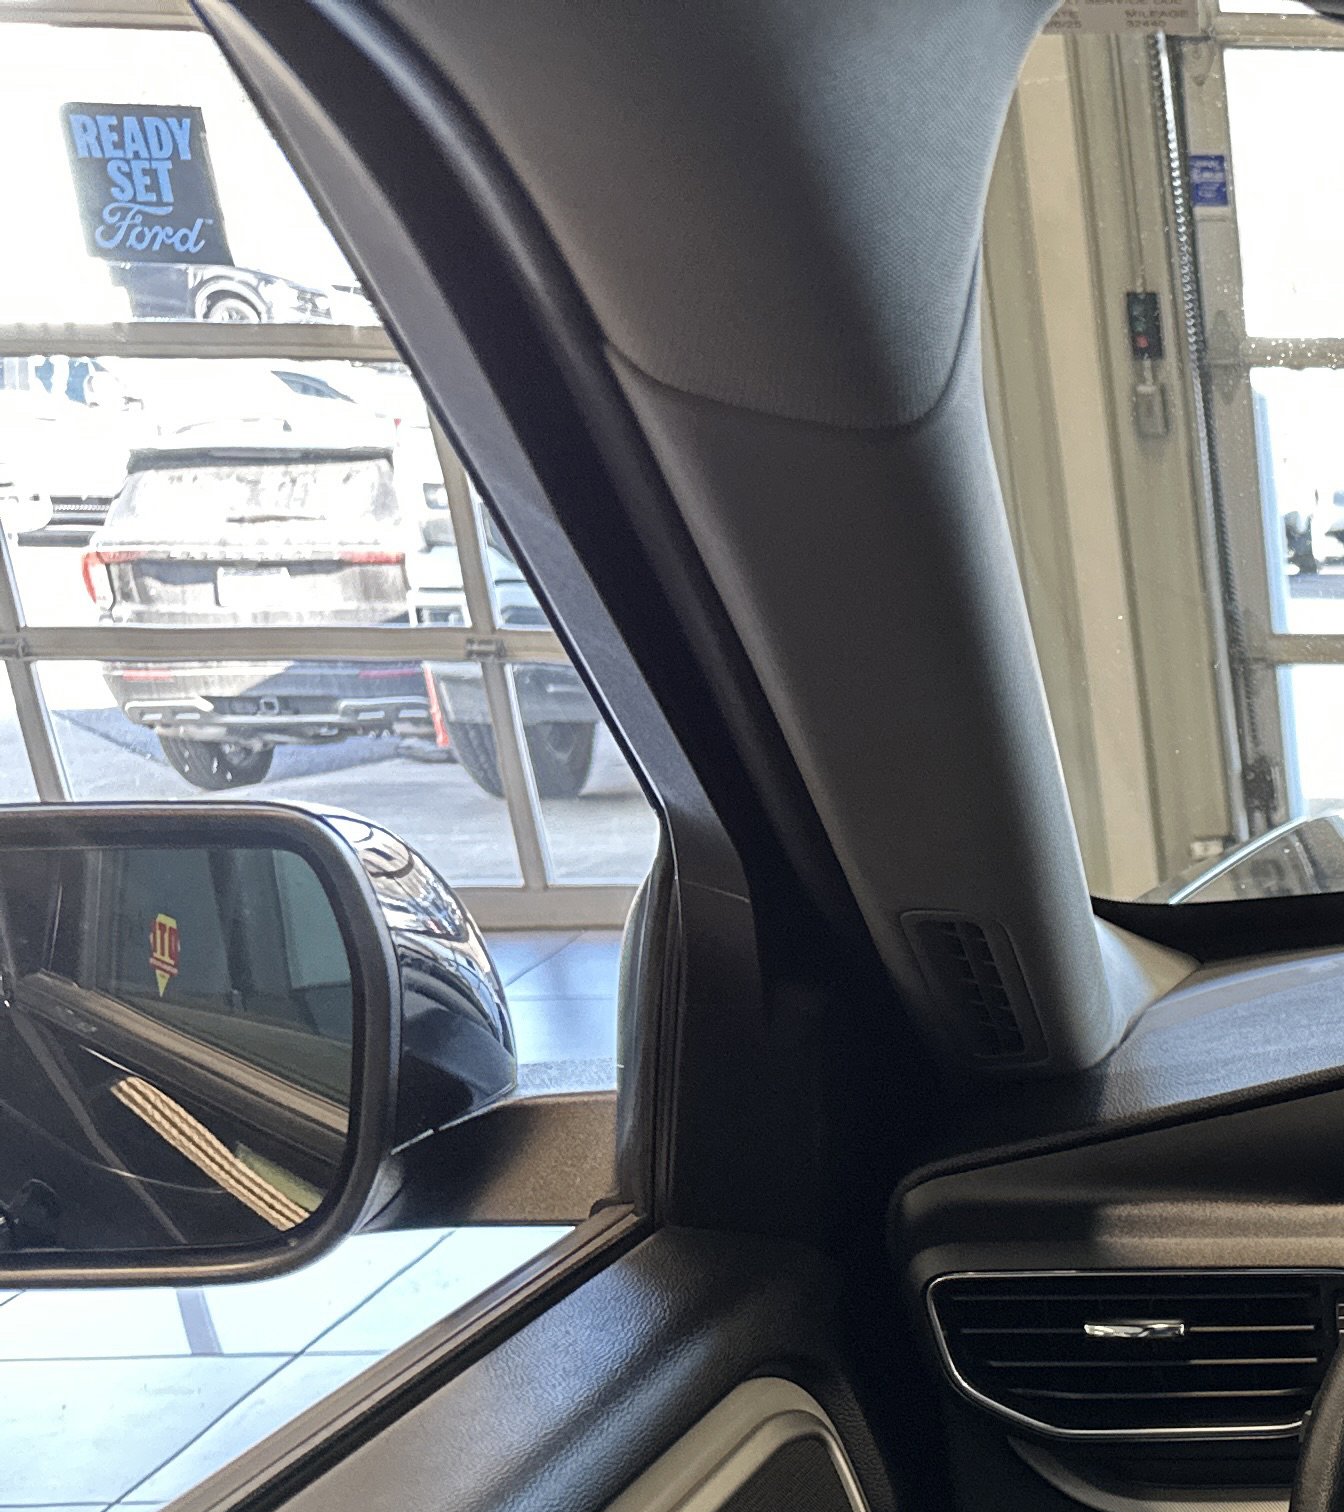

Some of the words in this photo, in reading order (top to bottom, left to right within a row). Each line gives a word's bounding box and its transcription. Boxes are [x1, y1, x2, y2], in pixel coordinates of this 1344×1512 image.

[69, 114, 192, 160] READY
[106, 159, 174, 202] SET
[95, 202, 206, 253] Ford
